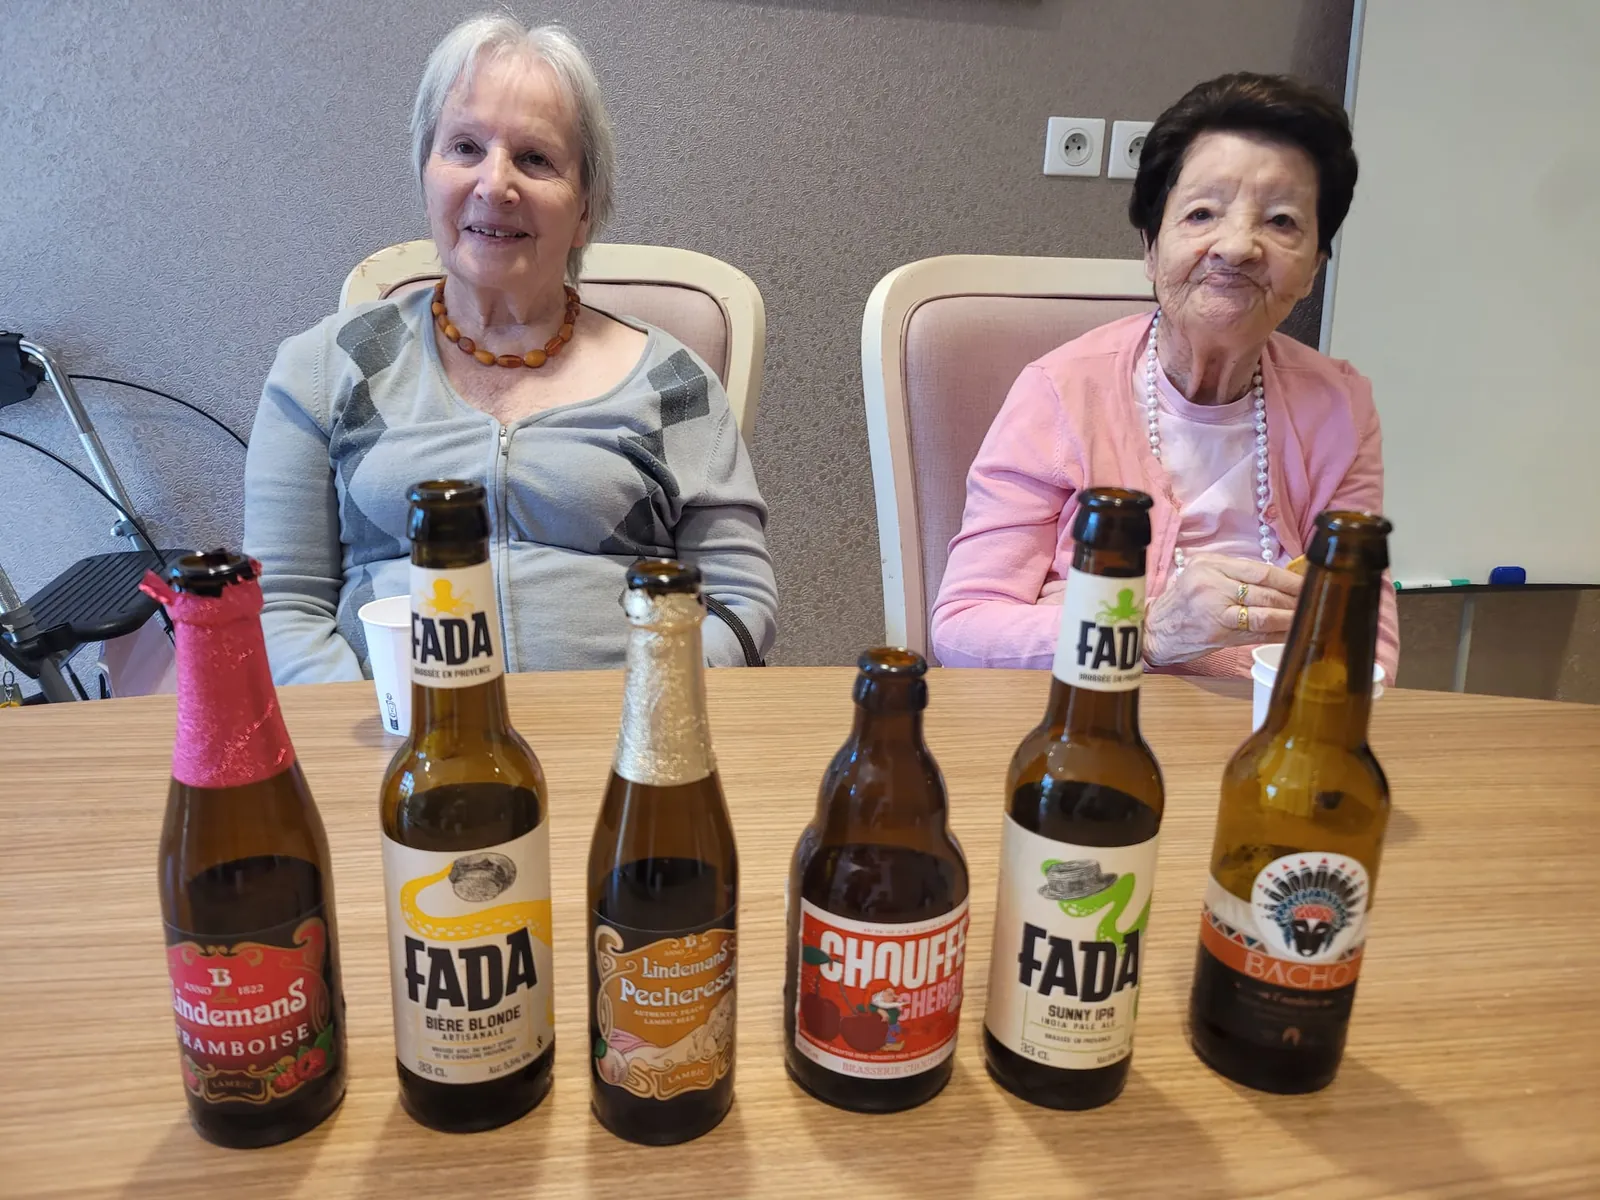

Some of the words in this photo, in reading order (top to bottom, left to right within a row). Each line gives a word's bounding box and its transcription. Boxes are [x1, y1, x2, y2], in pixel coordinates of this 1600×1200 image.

[412, 612, 493, 665] FADA
[1077, 620, 1143, 670] FAD
[442, 670, 452, 678] EN
[454, 665, 492, 678] PROVENCE
[405, 926, 538, 1012] FADA
[1018, 921, 1140, 1003] FADA
[1244, 952, 1353, 988] BACHO
[184, 982, 212, 996] ANNO
[238, 983, 264, 996] 1822
[425, 1014, 464, 1032] BIÈRE
[468, 1004, 522, 1030] BLONDE
[1048, 1004, 1092, 1021] SUNNY
[1095, 1006, 1116, 1021] IPA
[1041, 1017, 1067, 1029] INDIA
[1073, 1019, 1096, 1031] PALE
[442, 1027, 504, 1041] ARTISANALE
[418, 1061, 432, 1074] 33
[668, 1067, 706, 1084] LAMBIC
